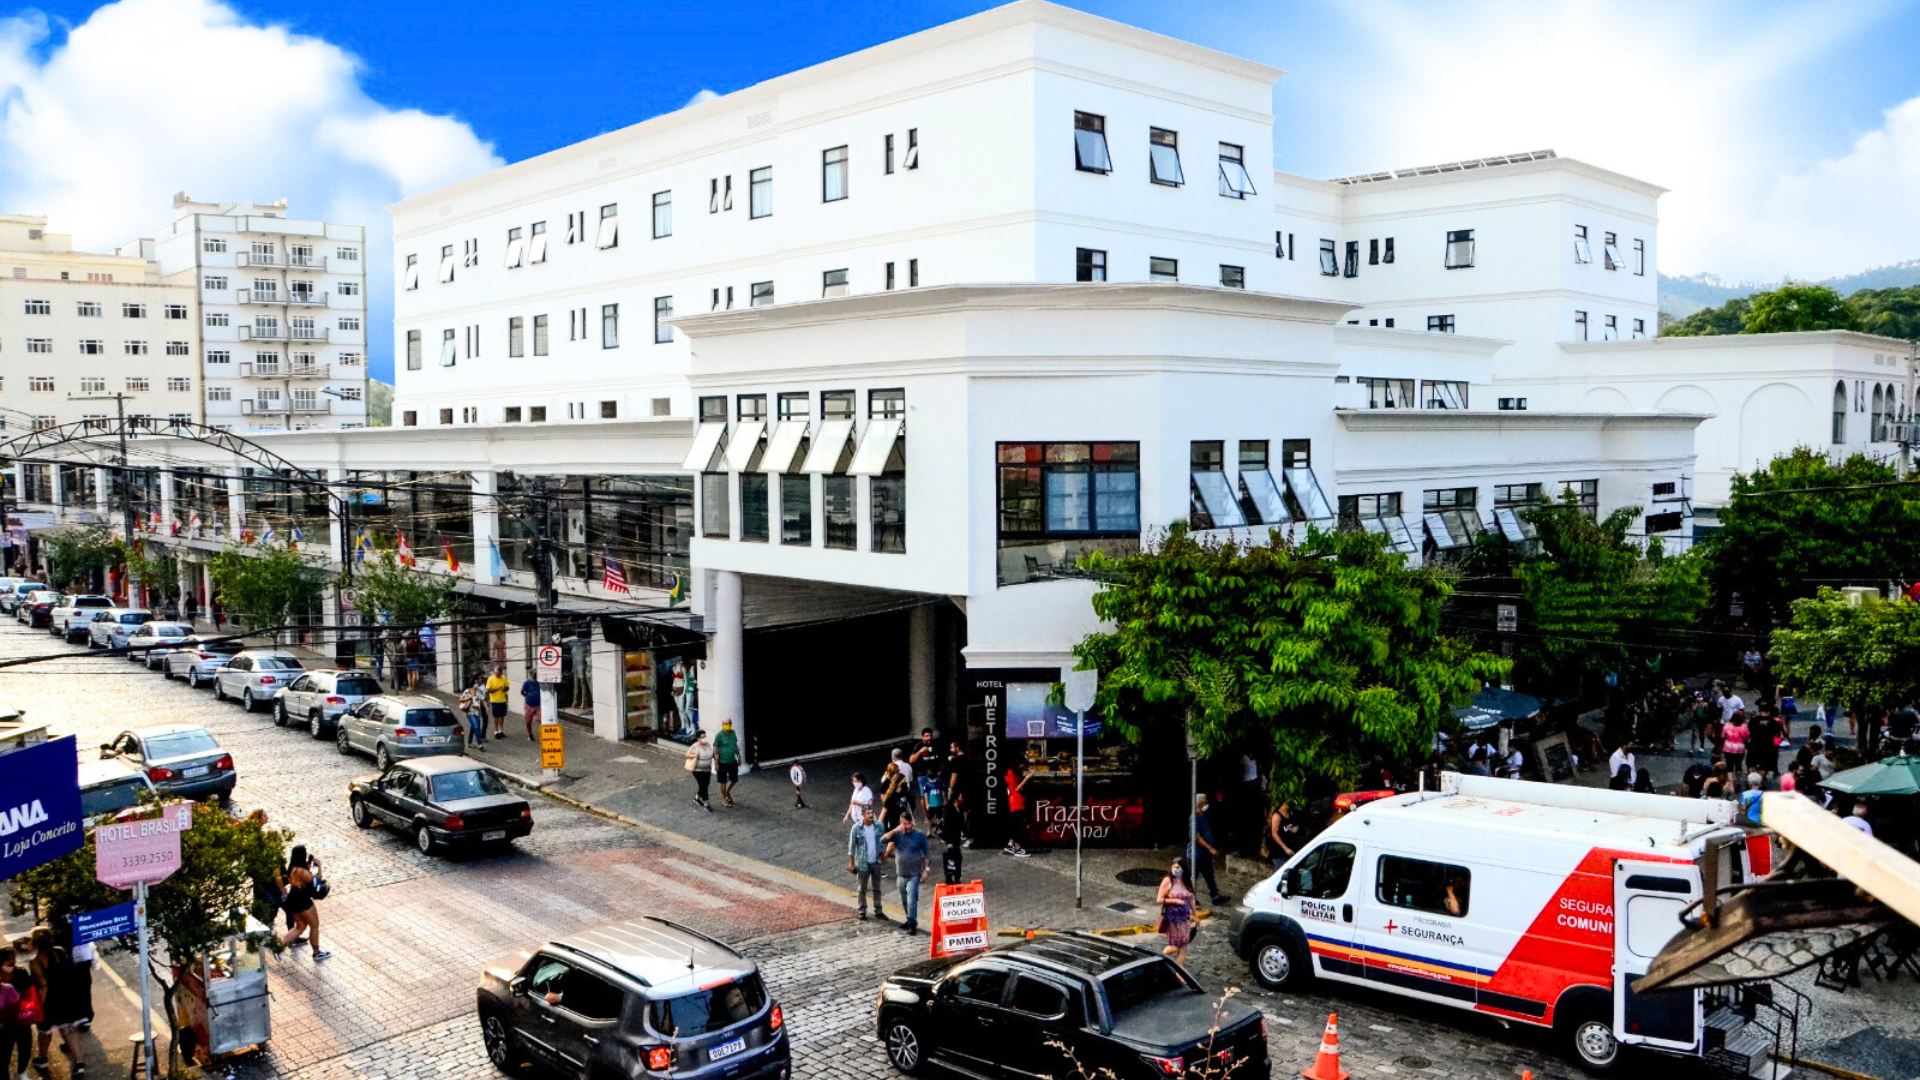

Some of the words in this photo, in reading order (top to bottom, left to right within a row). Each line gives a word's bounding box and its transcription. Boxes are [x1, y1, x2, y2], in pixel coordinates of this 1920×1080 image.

[985, 695, 997, 814] METROPOLE
[1036, 800, 1122, 822] Prazeres
[99, 825, 137, 843] HOTEL
[141, 818, 179, 837] BRASIL
[1061, 823, 1110, 838] Mnas
[4, 837, 30, 858] Loja
[32, 821, 77, 846] Conceito
[943, 898, 981, 908] OPERAÇÃO
[1301, 900, 1335, 912] POLÍCIA
[1560, 898, 1613, 916] SEGURA
[947, 908, 978, 917] POLICIAL
[1301, 909, 1336, 920] MILITAR
[1413, 916, 1452, 928] PROGRAMA
[949, 936, 982, 946] PMMG
[1401, 925, 1464, 946] SEGURANÇA
